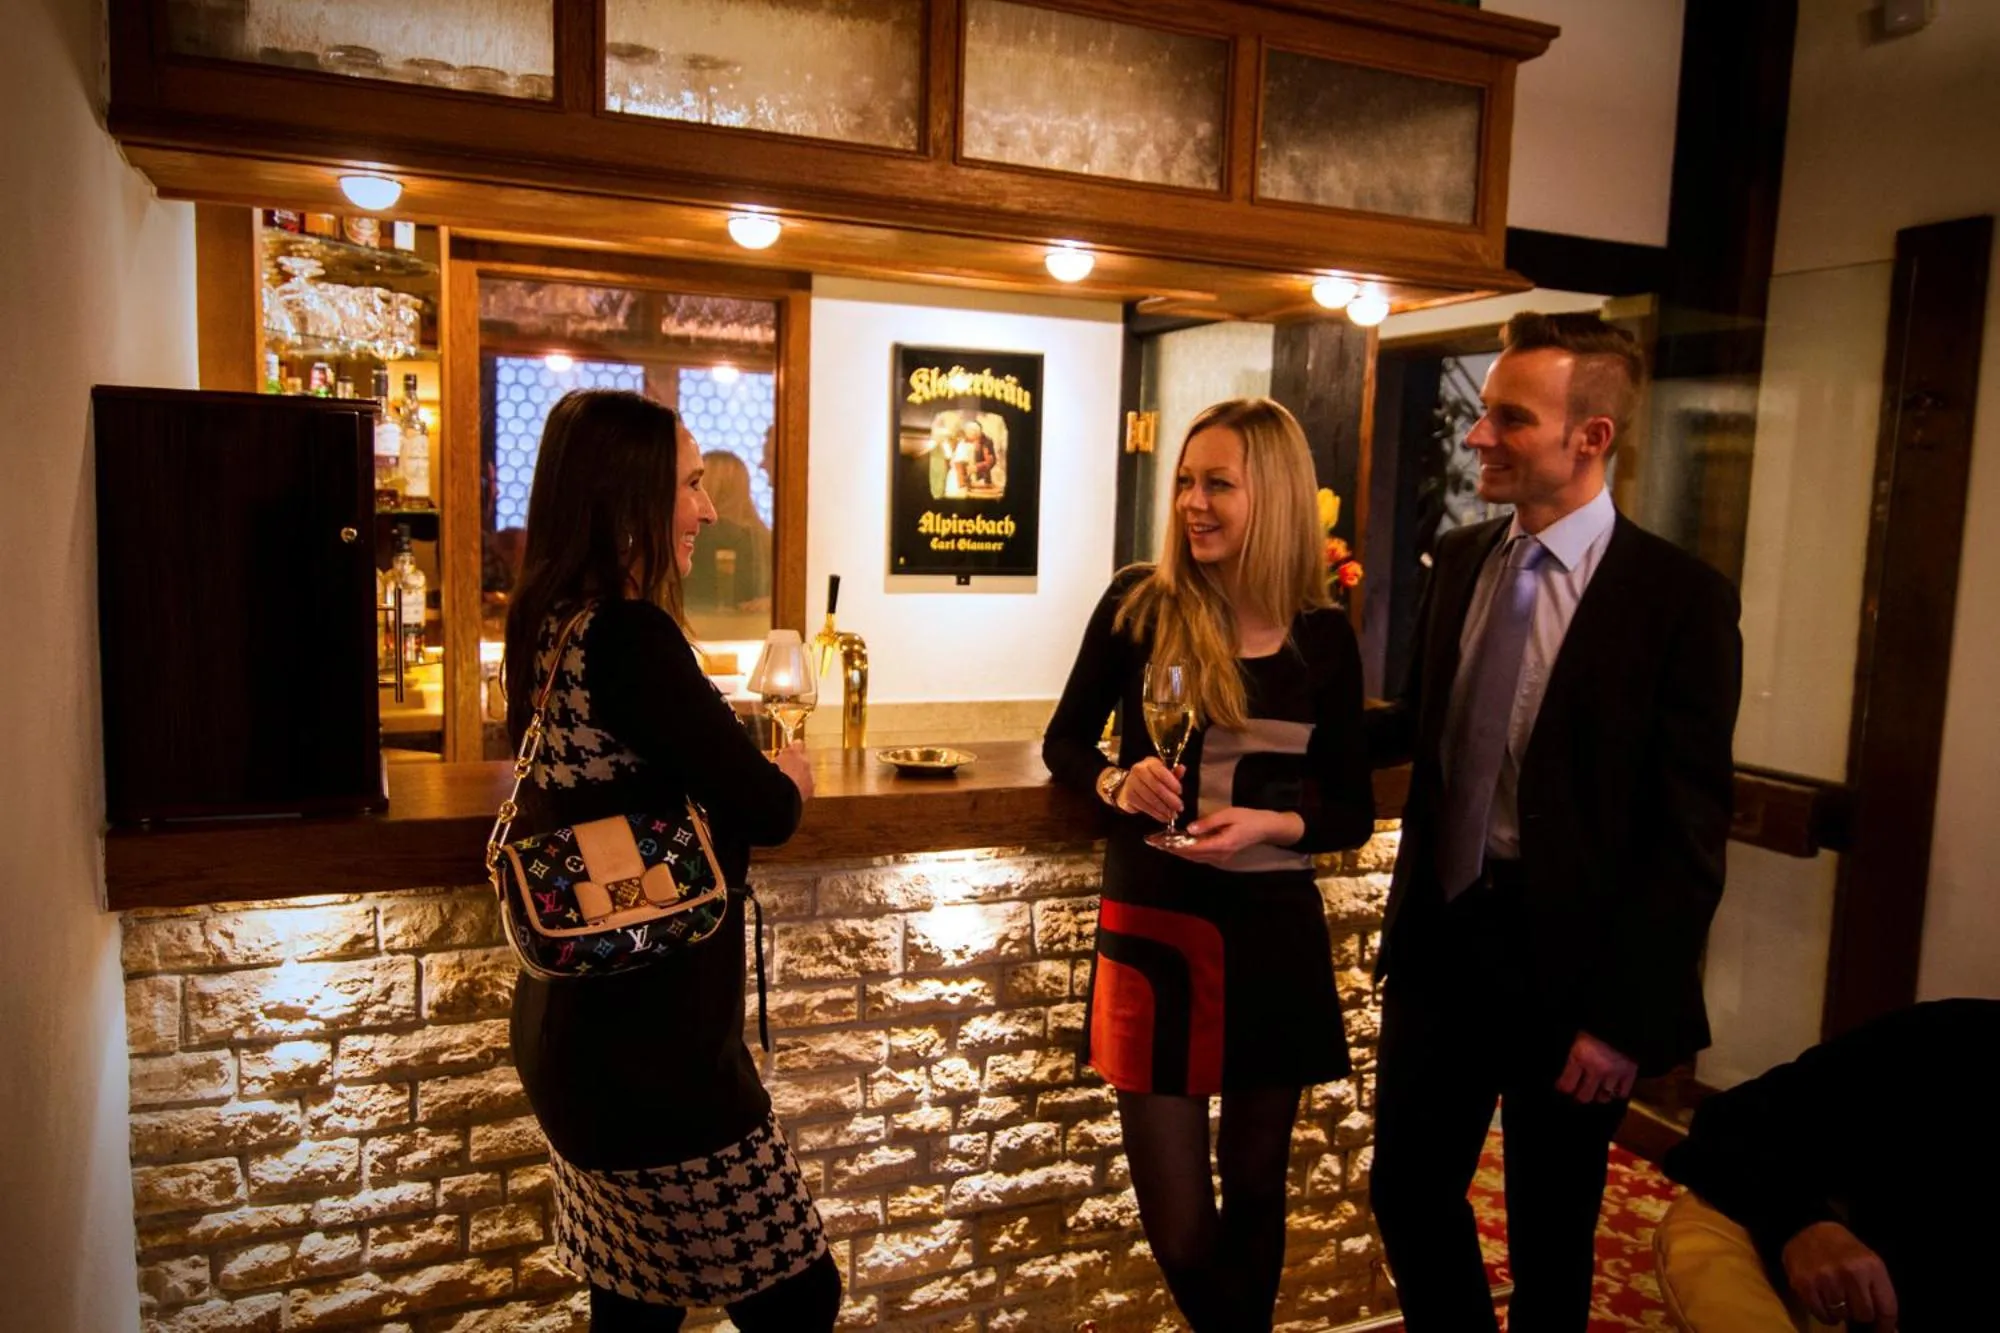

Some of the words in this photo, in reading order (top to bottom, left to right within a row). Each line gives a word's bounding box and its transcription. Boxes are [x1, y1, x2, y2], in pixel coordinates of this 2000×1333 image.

[918, 511, 1016, 537] Alpirsbach
[930, 537, 956, 551] Carl
[957, 537, 1004, 551] Glauner
[627, 925, 651, 953] LV
